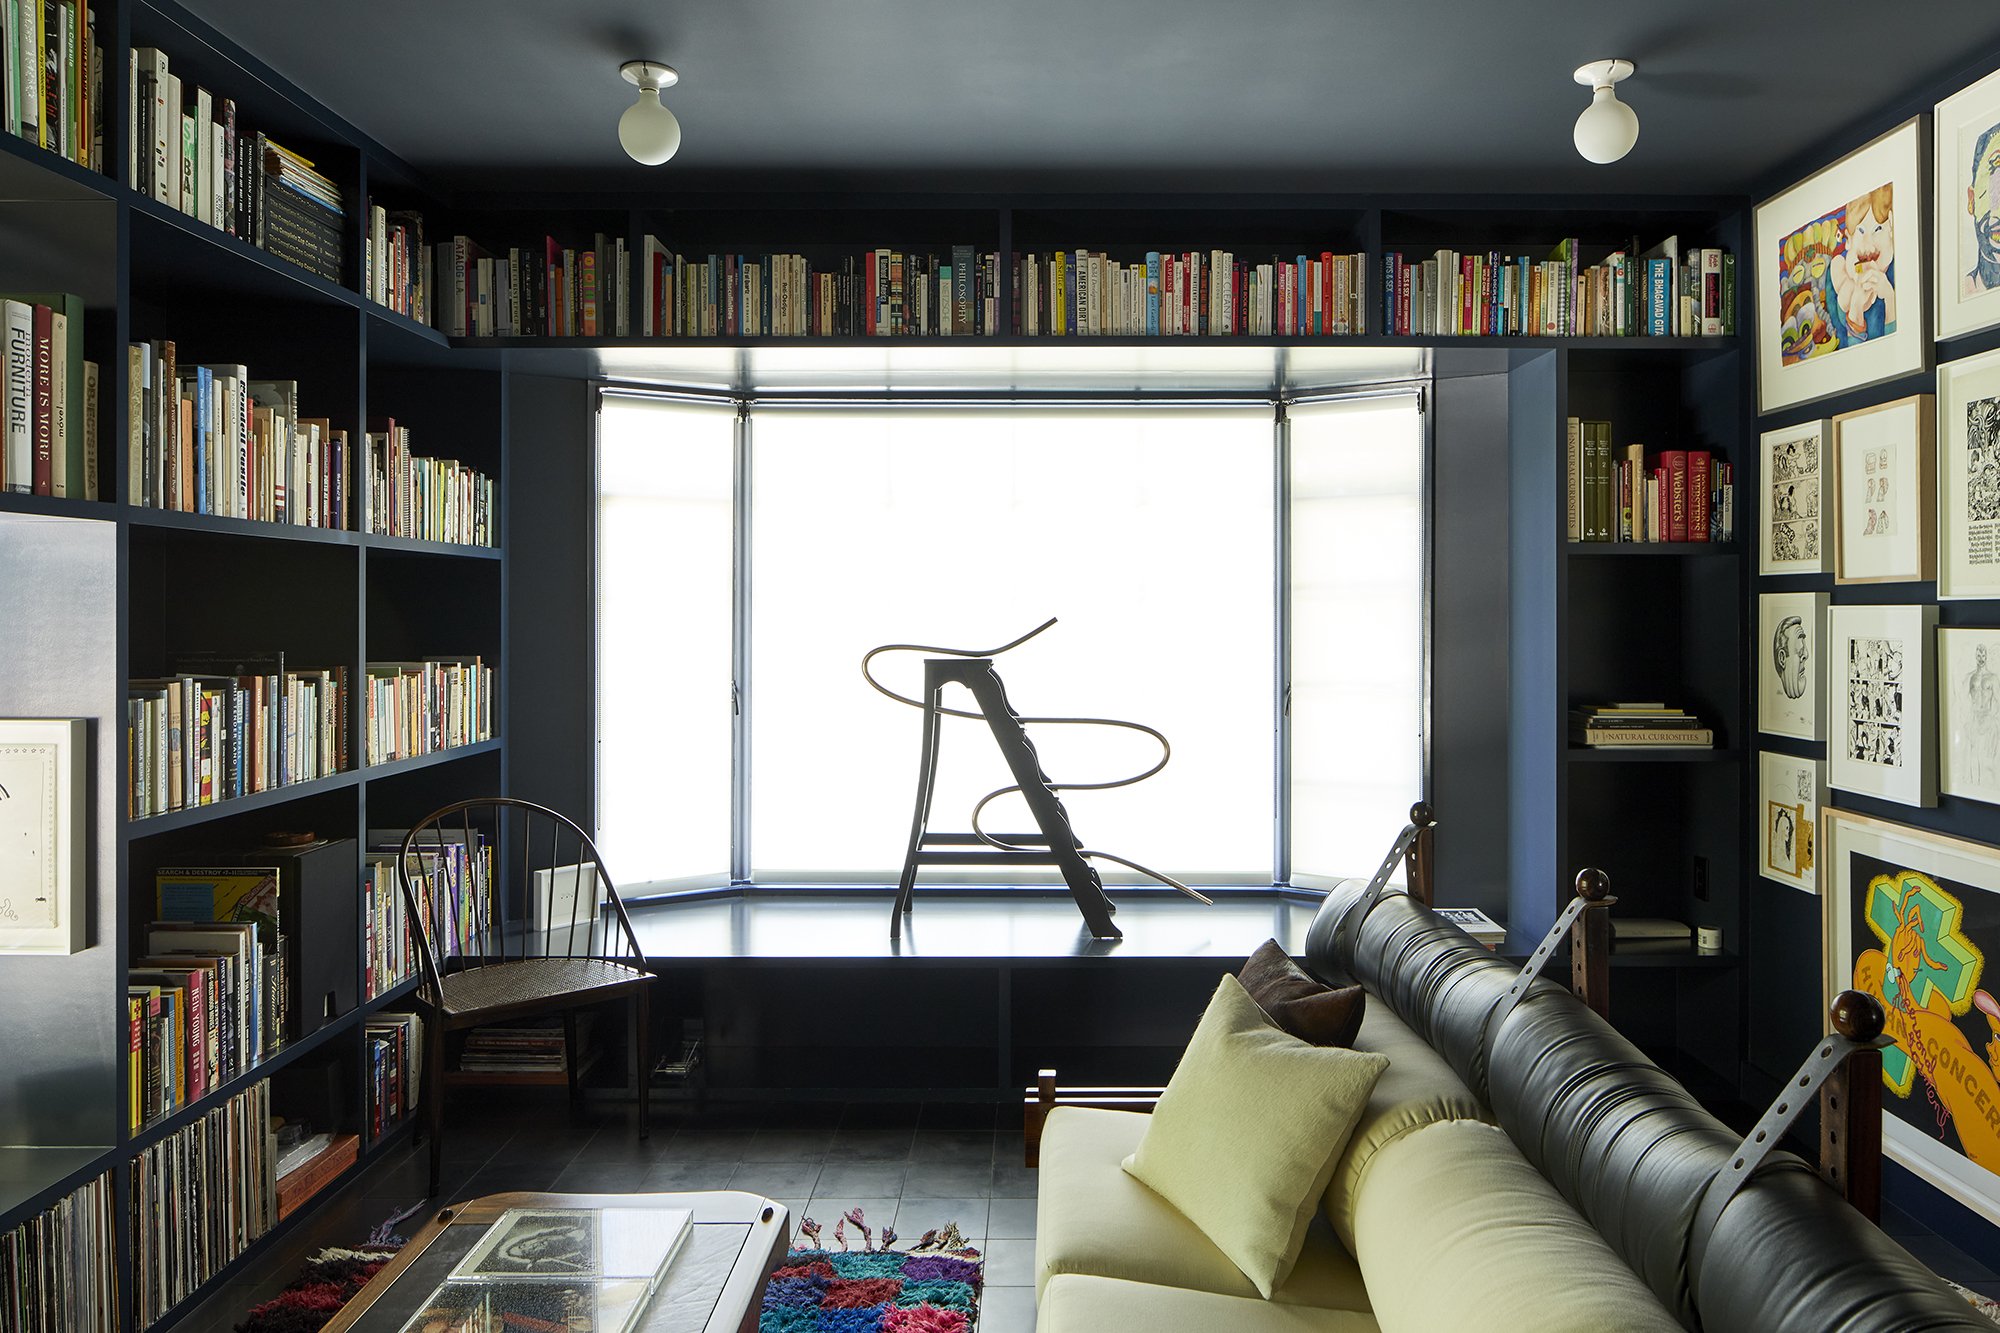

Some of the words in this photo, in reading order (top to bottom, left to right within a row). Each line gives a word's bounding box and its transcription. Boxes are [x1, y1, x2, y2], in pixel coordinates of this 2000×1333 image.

[455, 238, 465, 278] CATALOG
[1385, 256, 1394, 274] BOYS
[1654, 262, 1664, 278] THE
[455, 280, 464, 296] L.A.
[958, 262, 966, 324] PHILOSOPHY
[1078, 270, 1086, 305] AMERICAN
[1090, 278, 1098, 310] Development
[1223, 282, 1232, 314] CLEAN
[1385, 279, 1394, 293] SEX
[1654, 279, 1664, 318] BHAGAVAD
[1078, 307, 1086, 323] DIRT
[1654, 319, 1664, 336] GITA
[39, 336, 50, 386] MORE
[11, 327, 26, 435] FURNITURE
[40, 391, 49, 407] IS
[38, 412, 49, 461] MORE
[1673, 470, 1684, 522] Webster's
[1690, 474, 1701, 531] WEBSTER'S
[1607, 733, 1647, 741] NATURAL
[192, 1013, 200, 1047] YOUNG
